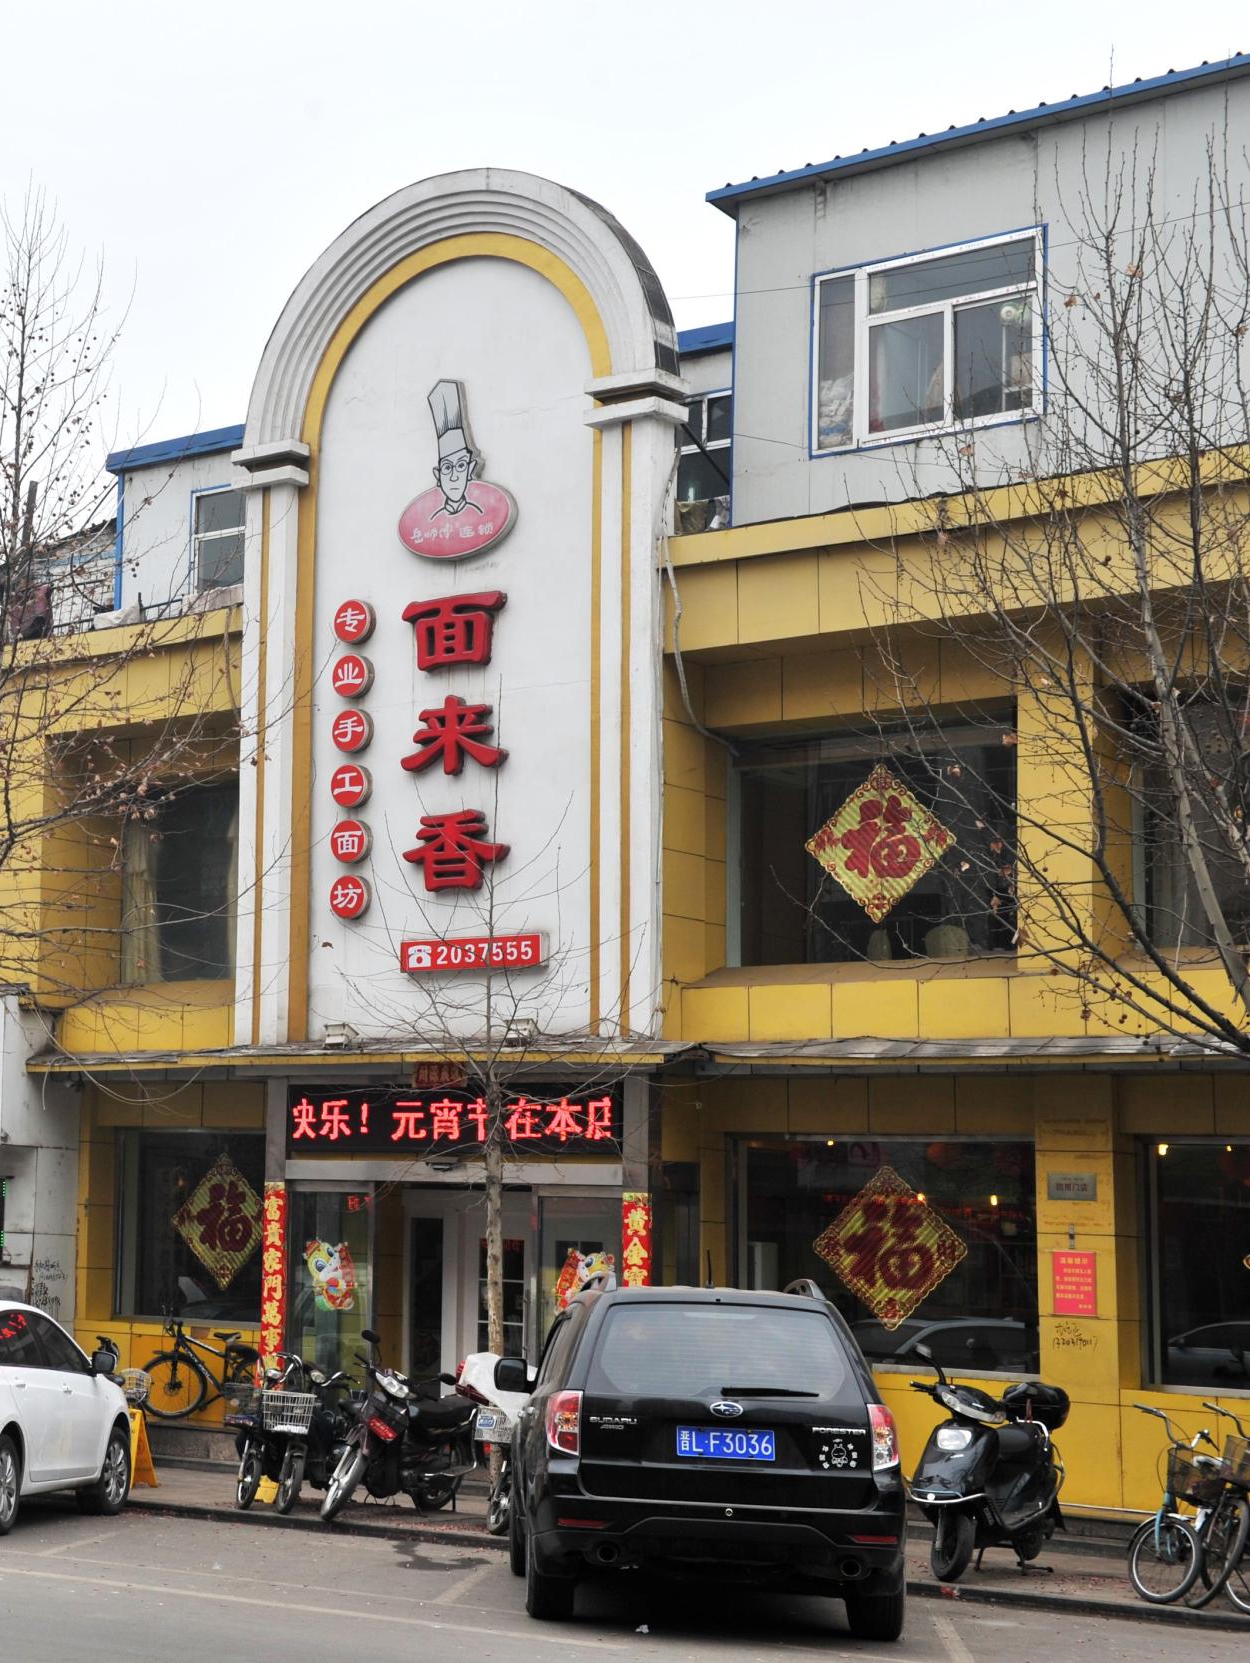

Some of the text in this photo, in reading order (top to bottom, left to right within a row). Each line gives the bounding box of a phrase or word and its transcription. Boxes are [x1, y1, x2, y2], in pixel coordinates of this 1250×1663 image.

[333, 606, 365, 899] 专业手工面坊
[400, 591, 511, 892] 面来香
[436, 943, 534, 965] 2037555
[590, 1416, 638, 1425] SUBARU
[812, 1427, 867, 1435] FORESTER
